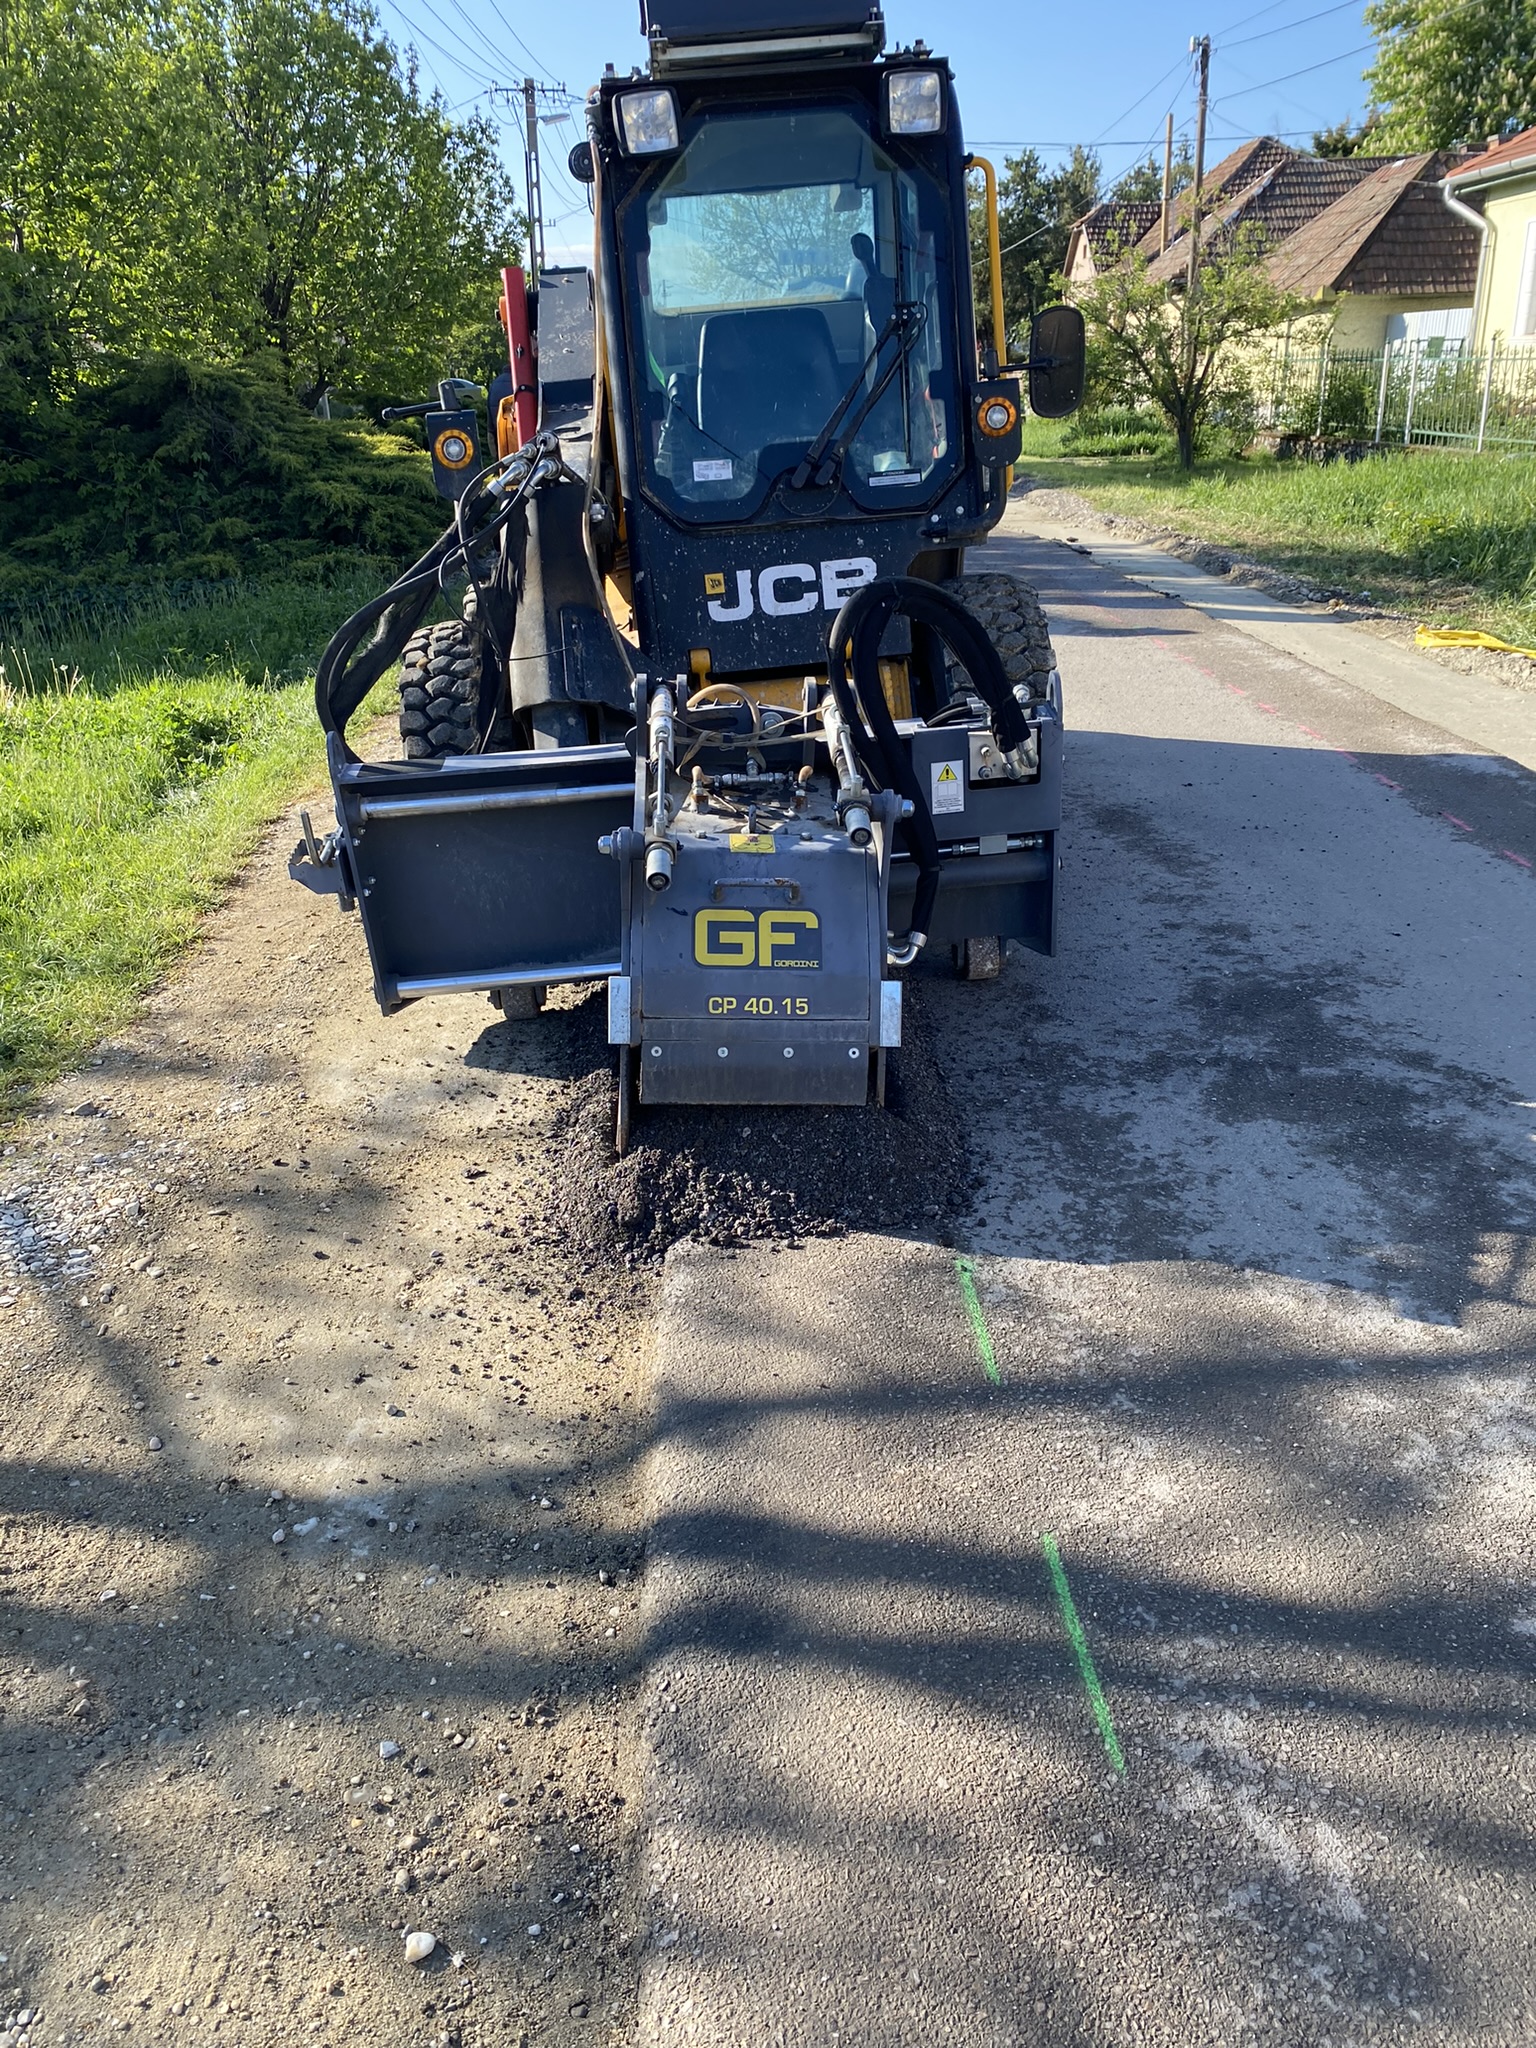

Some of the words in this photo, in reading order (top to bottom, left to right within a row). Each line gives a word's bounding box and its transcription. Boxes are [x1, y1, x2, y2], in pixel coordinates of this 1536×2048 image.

[707, 557, 877, 622] JCB
[694, 909, 819, 967] GF
[773, 959, 820, 968] GORDINI
[708, 997, 737, 1014] CP
[743, 997, 809, 1015] 40.15
